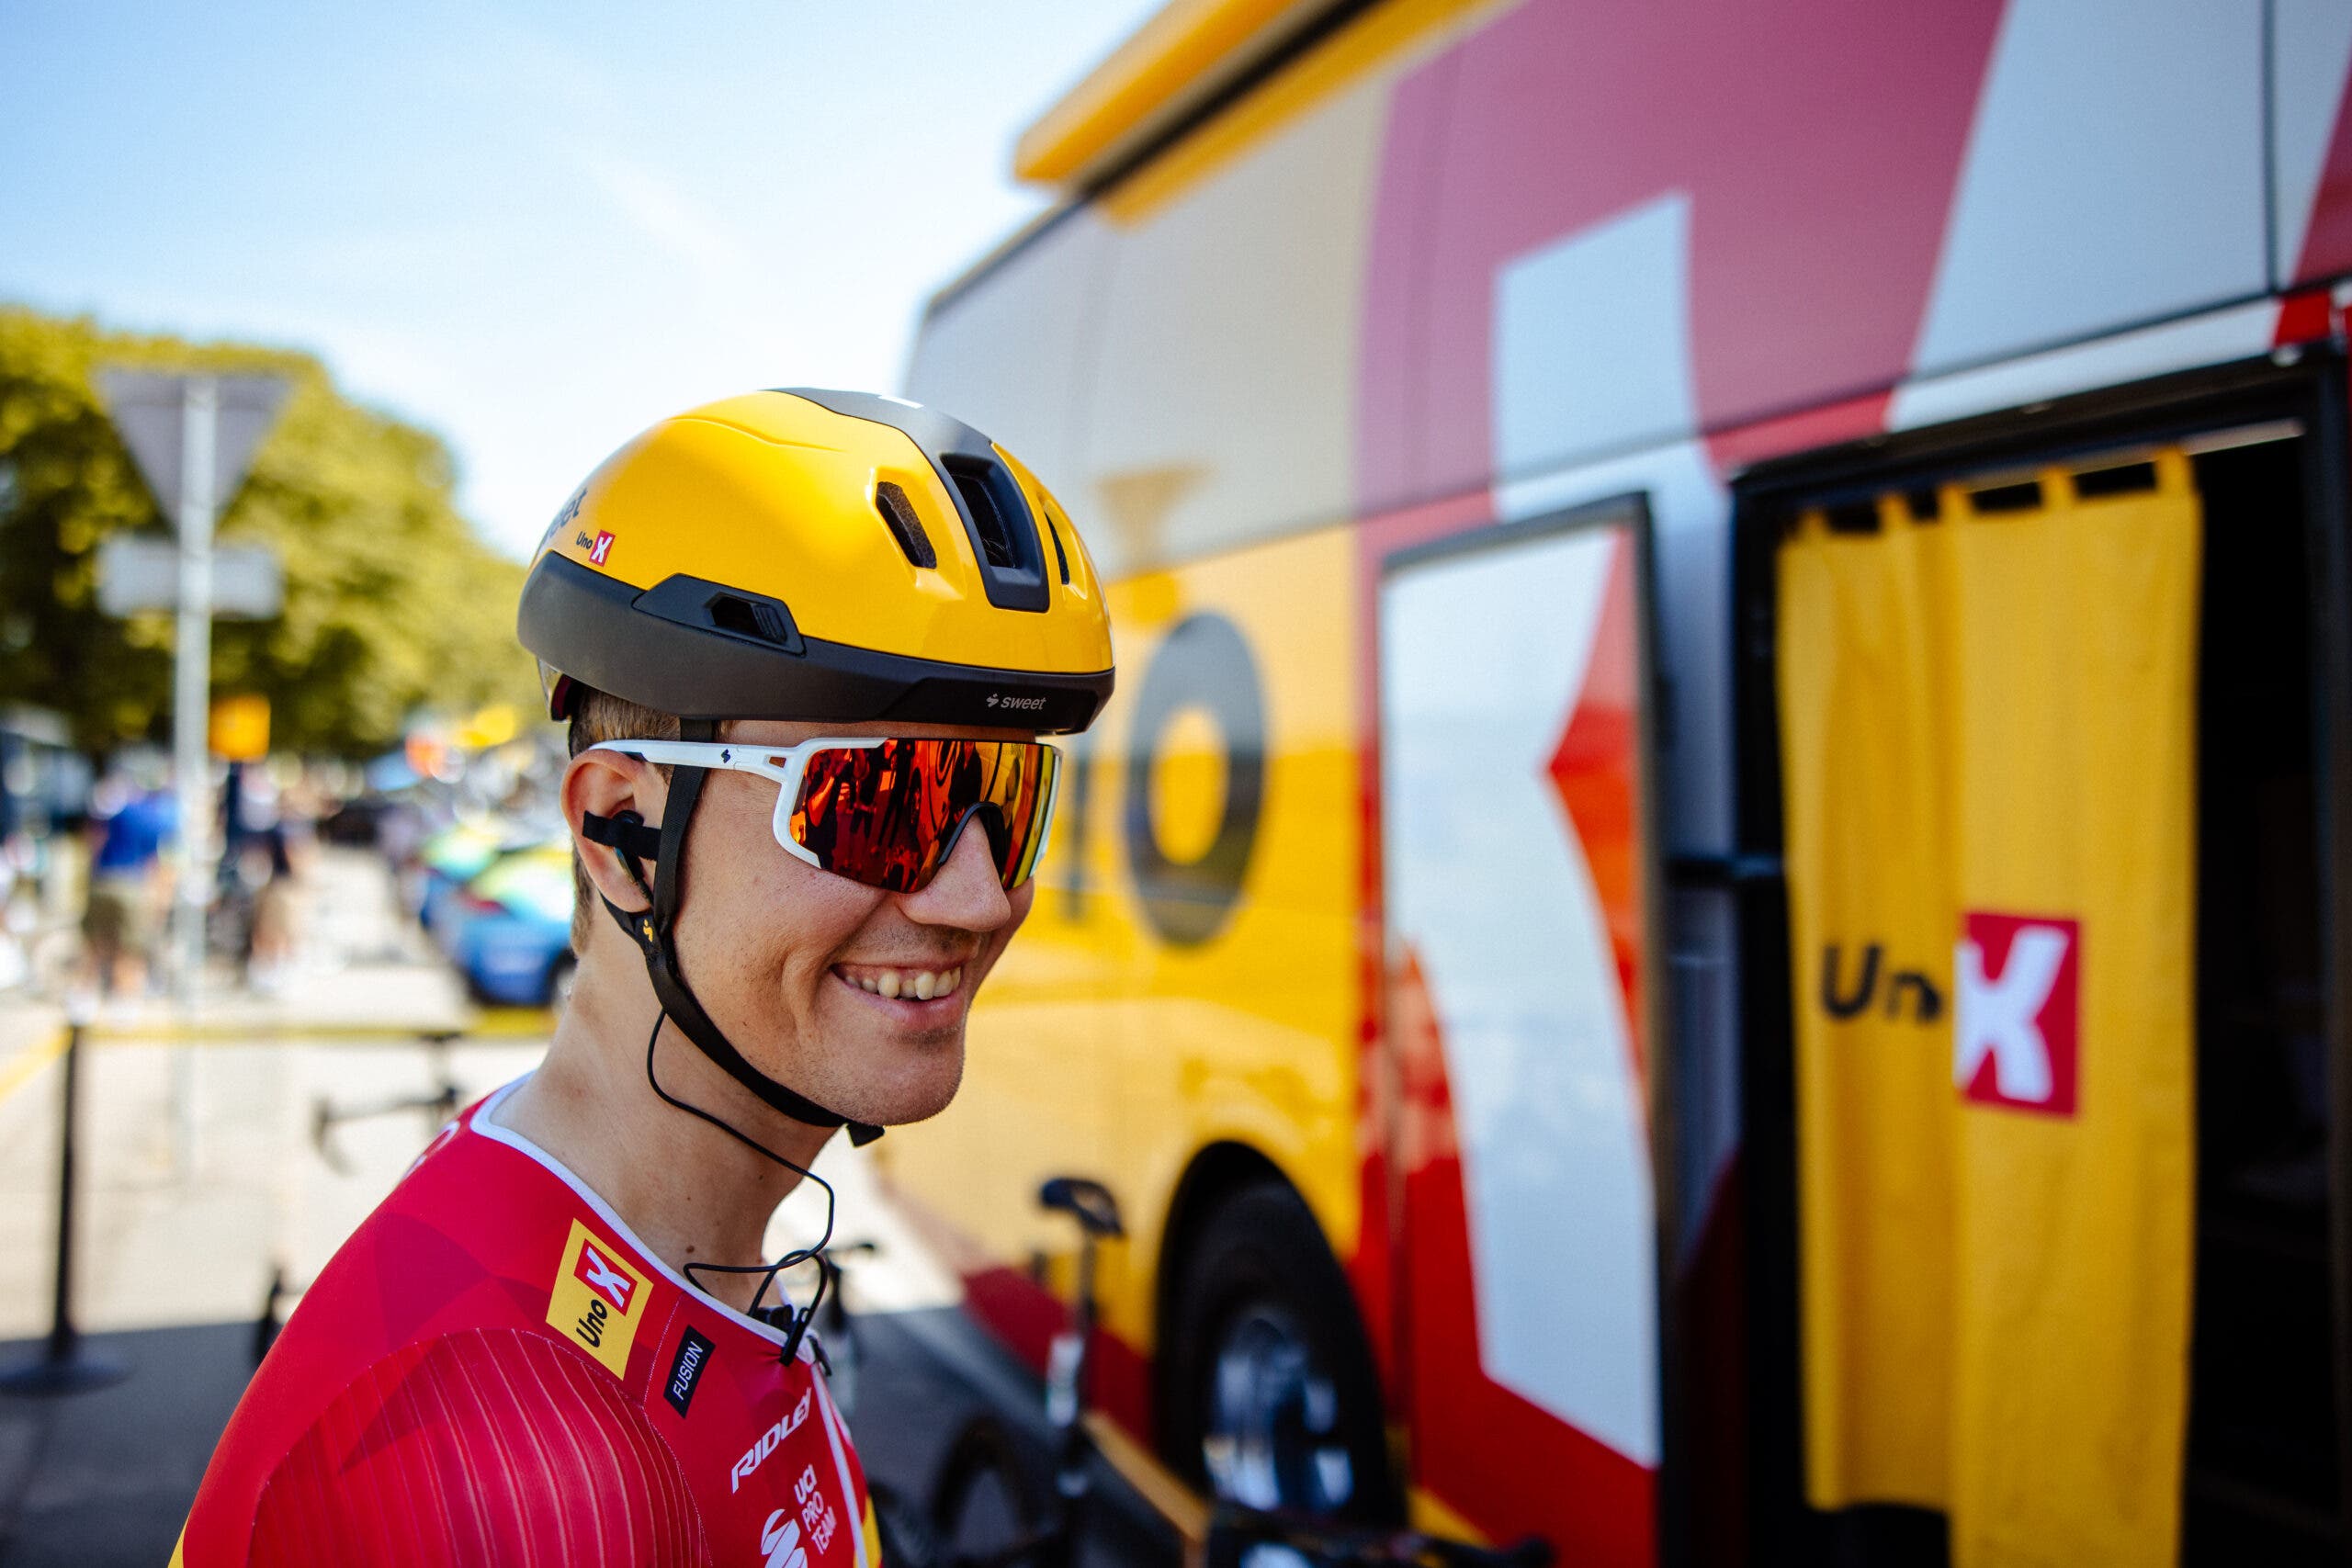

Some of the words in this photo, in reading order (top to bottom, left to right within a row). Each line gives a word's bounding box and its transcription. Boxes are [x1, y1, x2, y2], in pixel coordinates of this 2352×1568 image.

[575, 530, 594, 550] Uno
[591, 536, 613, 564] X
[1000, 696, 1047, 710] sweet
[1821, 941, 1943, 1026] Un
[585, 1246, 631, 1308] X
[575, 1298, 608, 1348] Uno
[672, 1340, 704, 1402] FUSION
[731, 1386, 812, 1495] RIDLEY
[793, 1463, 818, 1506] UCI
[801, 1491, 824, 1532] PRO
[810, 1506, 837, 1555] TEAM
